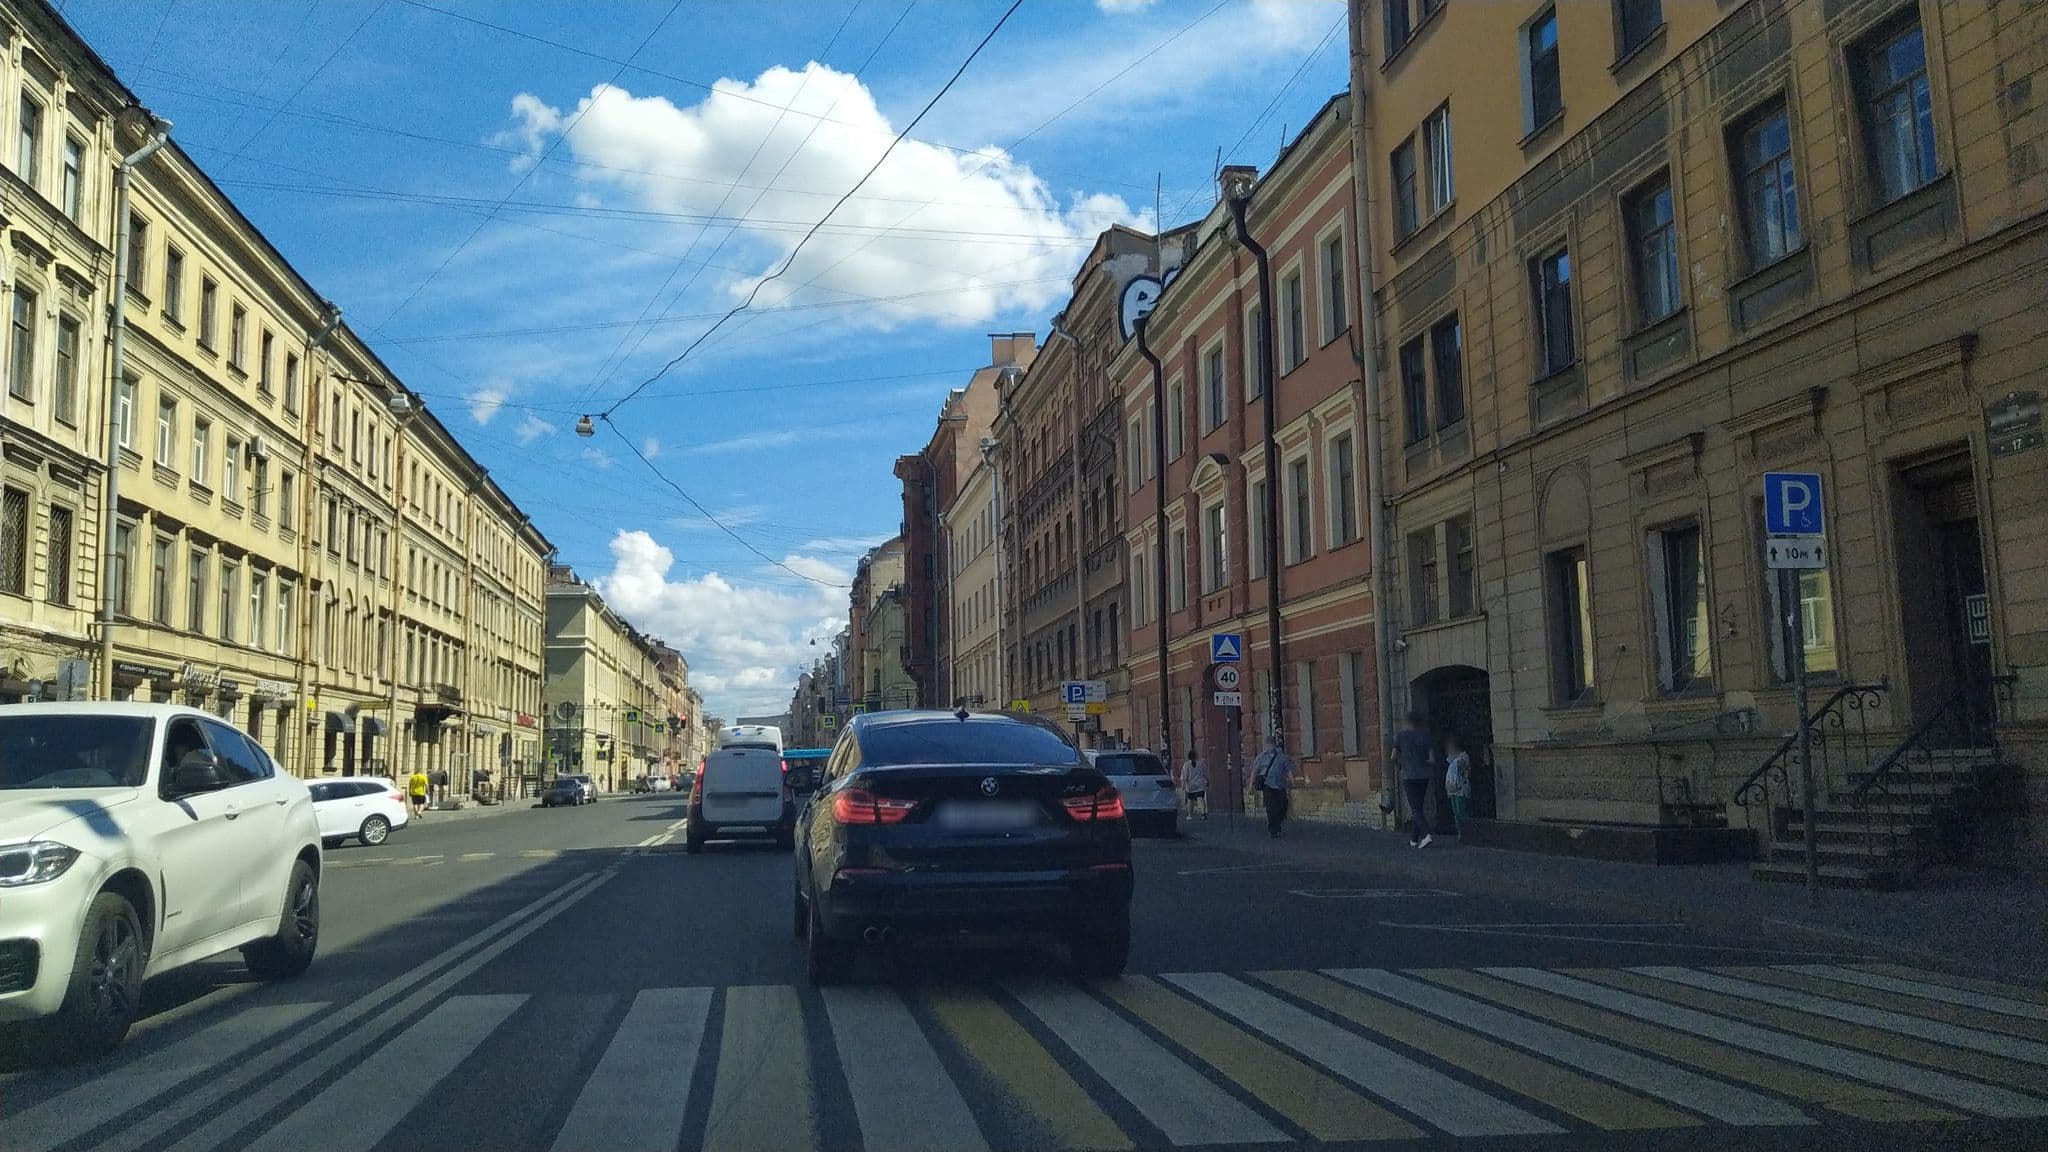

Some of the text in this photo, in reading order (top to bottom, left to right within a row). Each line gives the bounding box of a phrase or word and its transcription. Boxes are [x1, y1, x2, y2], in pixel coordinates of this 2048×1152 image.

[2011, 438, 2022, 450] 17
[1781, 480, 1811, 527] P
[1220, 671, 1236, 683] 40
[1072, 686, 1083, 702] P
